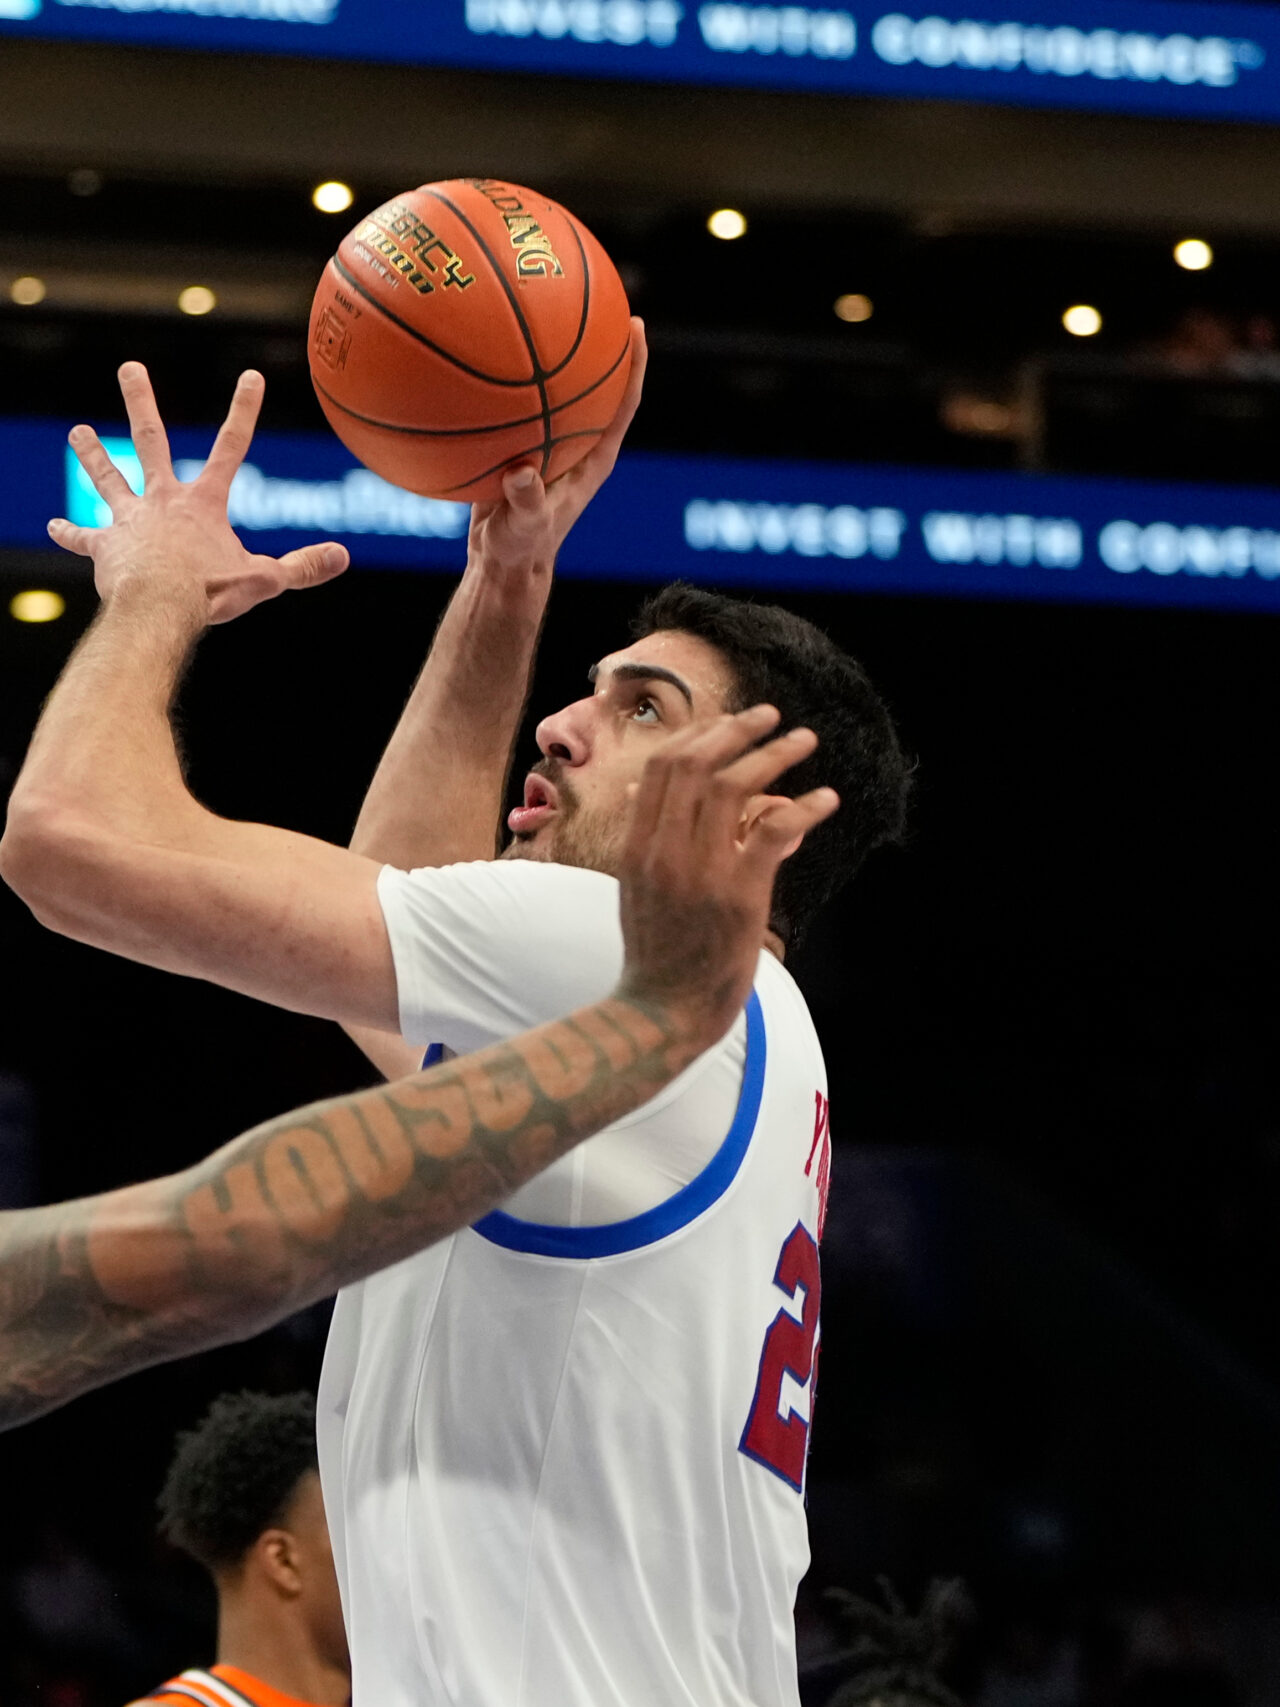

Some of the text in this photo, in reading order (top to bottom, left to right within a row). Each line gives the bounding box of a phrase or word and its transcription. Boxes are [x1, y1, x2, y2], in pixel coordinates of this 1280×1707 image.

[465, 0, 681, 47] INVEST
[699, 4, 856, 60] WITH
[685, 499, 905, 560] INVEST
[922, 510, 1083, 569] WITH
[738, 1219, 822, 1493] 2
